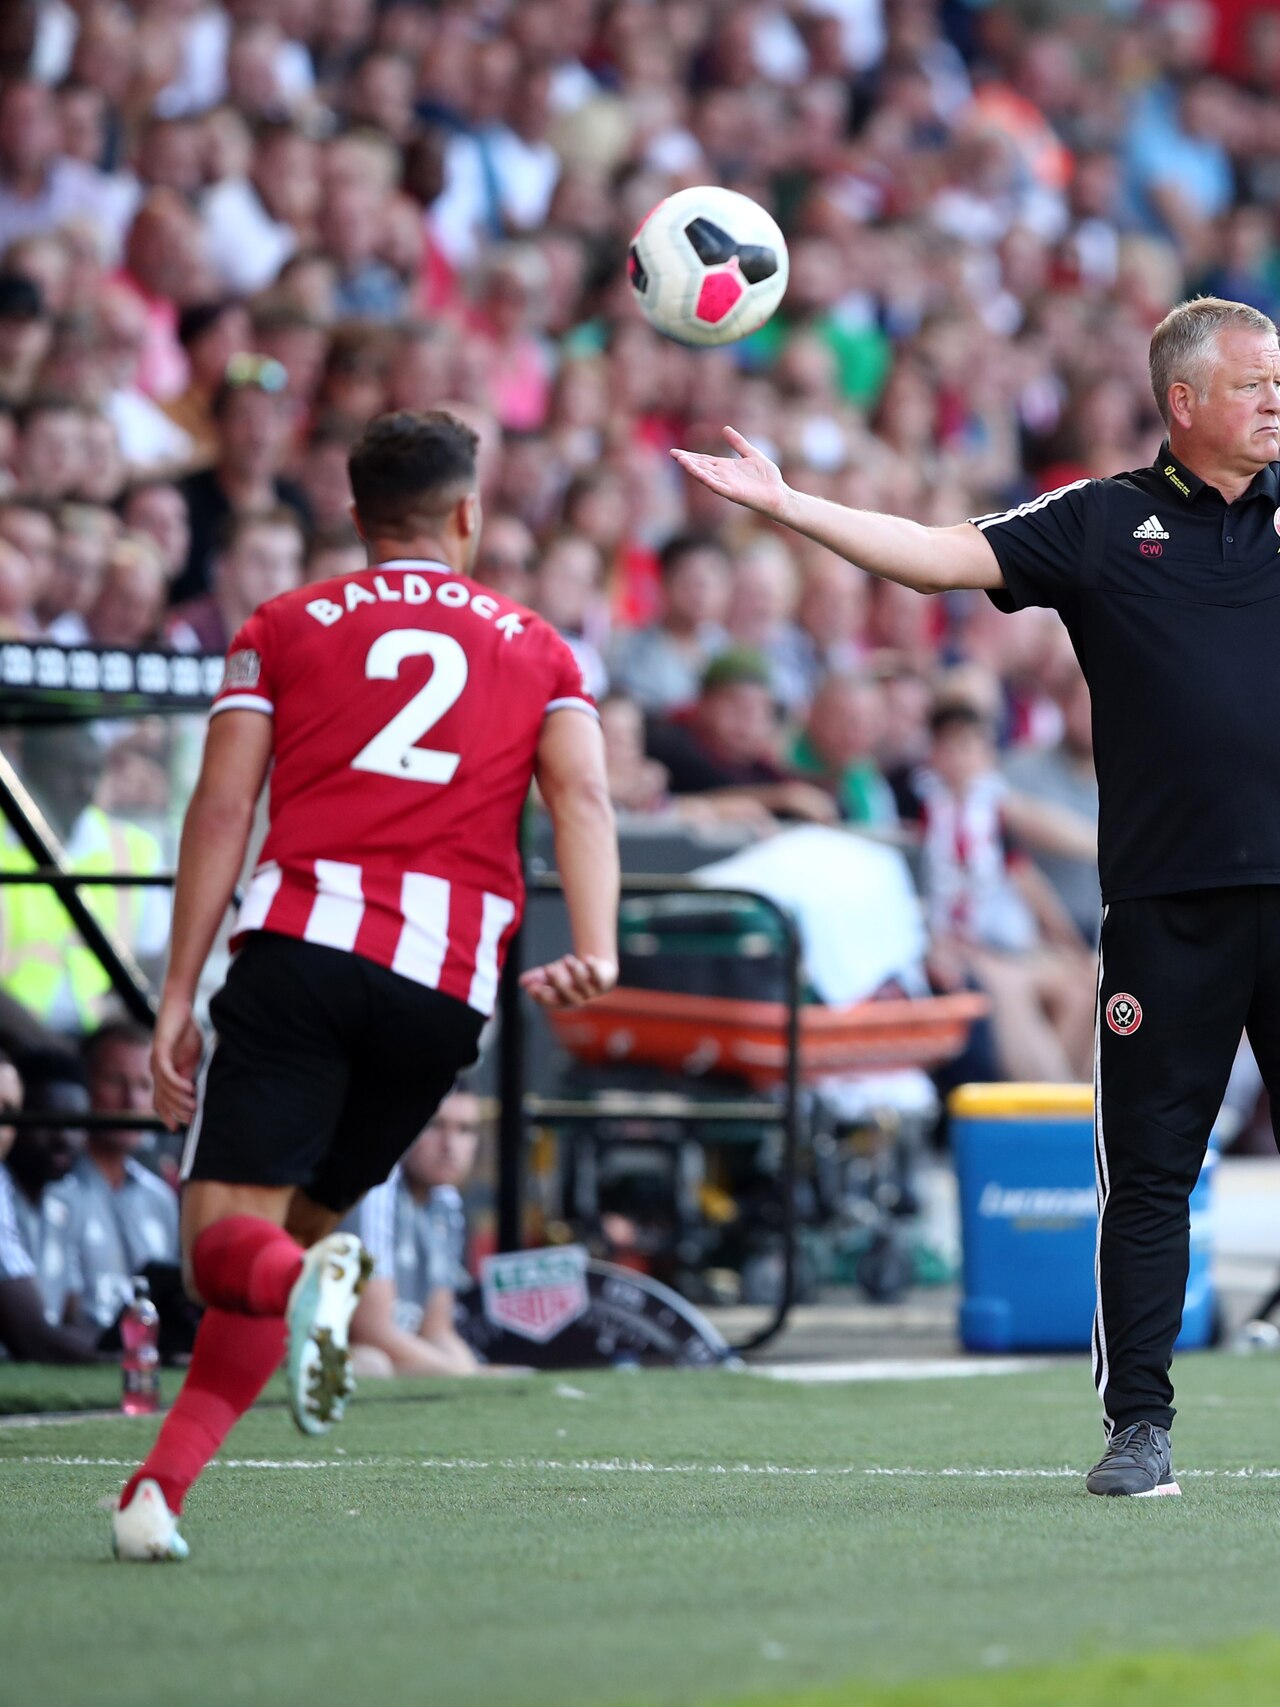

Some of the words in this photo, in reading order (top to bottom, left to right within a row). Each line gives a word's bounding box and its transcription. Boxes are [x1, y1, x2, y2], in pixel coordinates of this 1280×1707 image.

[1132, 530, 1170, 540] adidas
[1141, 544, 1160, 555] CW
[305, 573, 524, 642] BALDOCK
[350, 628, 469, 784] 2
